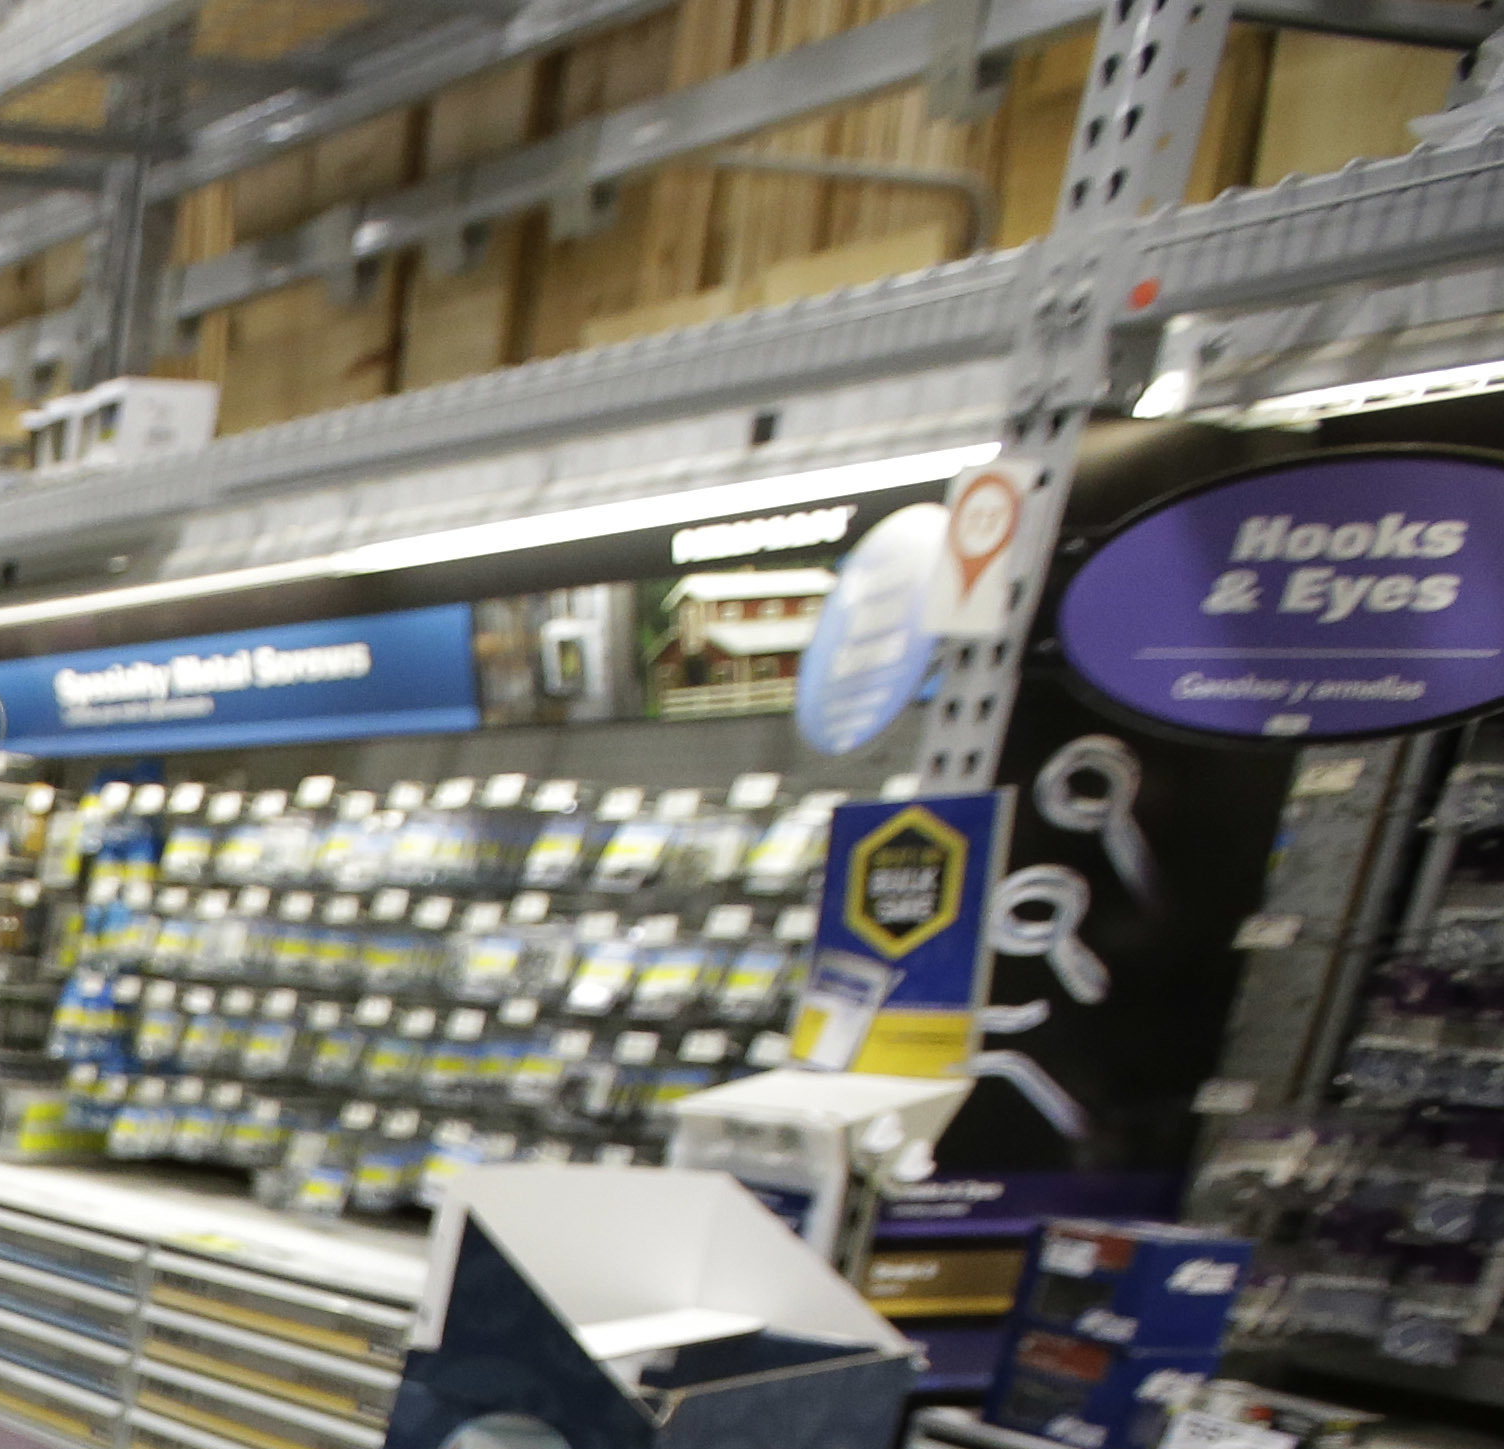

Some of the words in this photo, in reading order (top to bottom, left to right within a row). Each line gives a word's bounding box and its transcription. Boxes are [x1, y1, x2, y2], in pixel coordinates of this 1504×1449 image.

[1229, 512, 1470, 562] Hooks
[1201, 574, 1264, 615] &
[1277, 566, 1461, 625] Eyes
